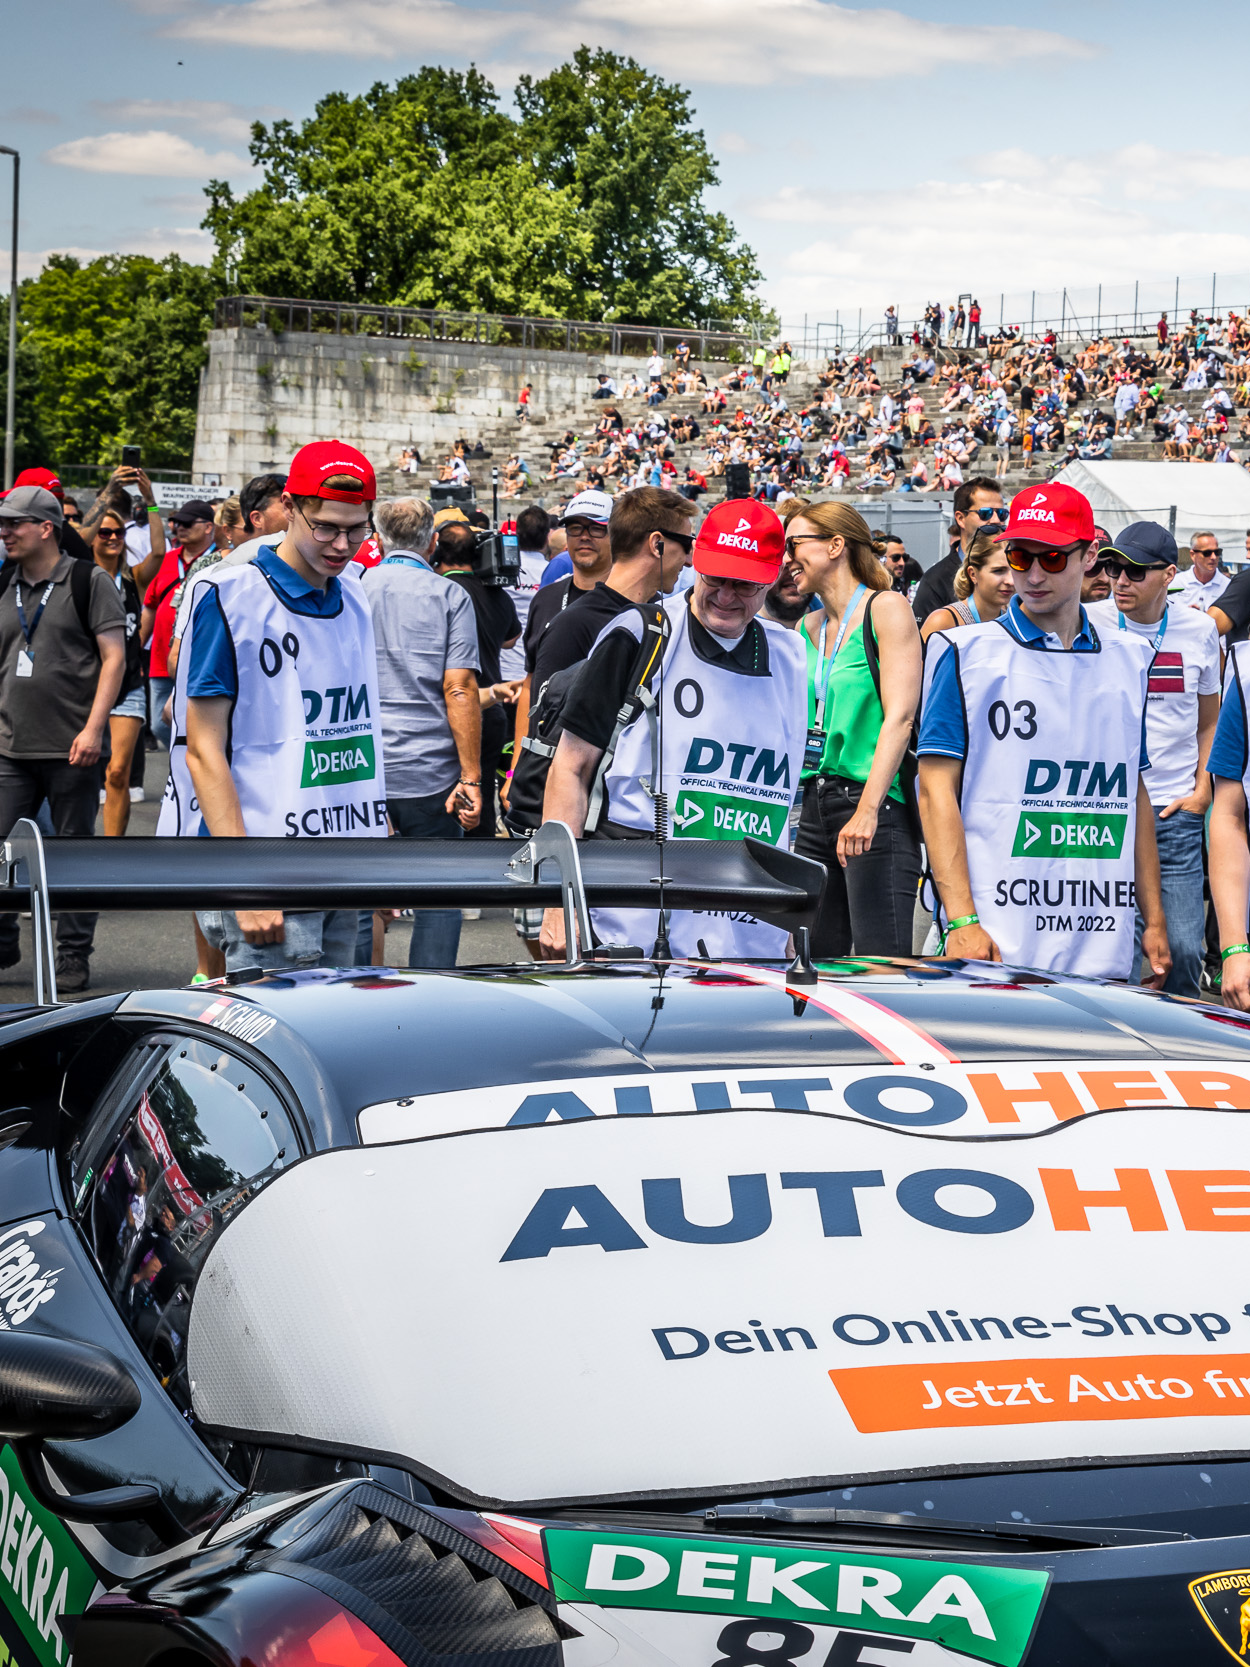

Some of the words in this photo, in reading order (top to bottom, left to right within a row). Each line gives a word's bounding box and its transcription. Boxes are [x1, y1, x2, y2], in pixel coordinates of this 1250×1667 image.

[1017, 508, 1055, 523] DEKRA
[717, 532, 758, 553] DEKRA
[301, 684, 371, 725] DTM
[988, 700, 1038, 741] 03
[318, 748, 369, 774] DEKRA
[684, 737, 790, 789] DTM
[680, 778, 716, 788] OFFICIAL
[718, 782, 758, 796] TECHNICAL
[758, 789, 790, 801] PARTNE
[1024, 759, 1128, 798] DTM
[713, 805, 772, 837] DEKRA
[1021, 799, 1054, 808] OFFICIAL
[1056, 801, 1095, 809] TECHNICAL
[1095, 802, 1128, 810] PARTNER
[1050, 824, 1116, 846] DEKRA
[1036, 915, 1073, 932] DTM
[1077, 915, 1116, 932] 2022
[213, 1003, 278, 1045] SCHMID
[650, 1319, 818, 1361] Dein
[832, 1303, 1232, 1346] Online-Shop
[921, 1376, 1055, 1410] Jetzt
[1067, 1373, 1195, 1404] Auto
[584, 1543, 998, 1642] DEKRA
